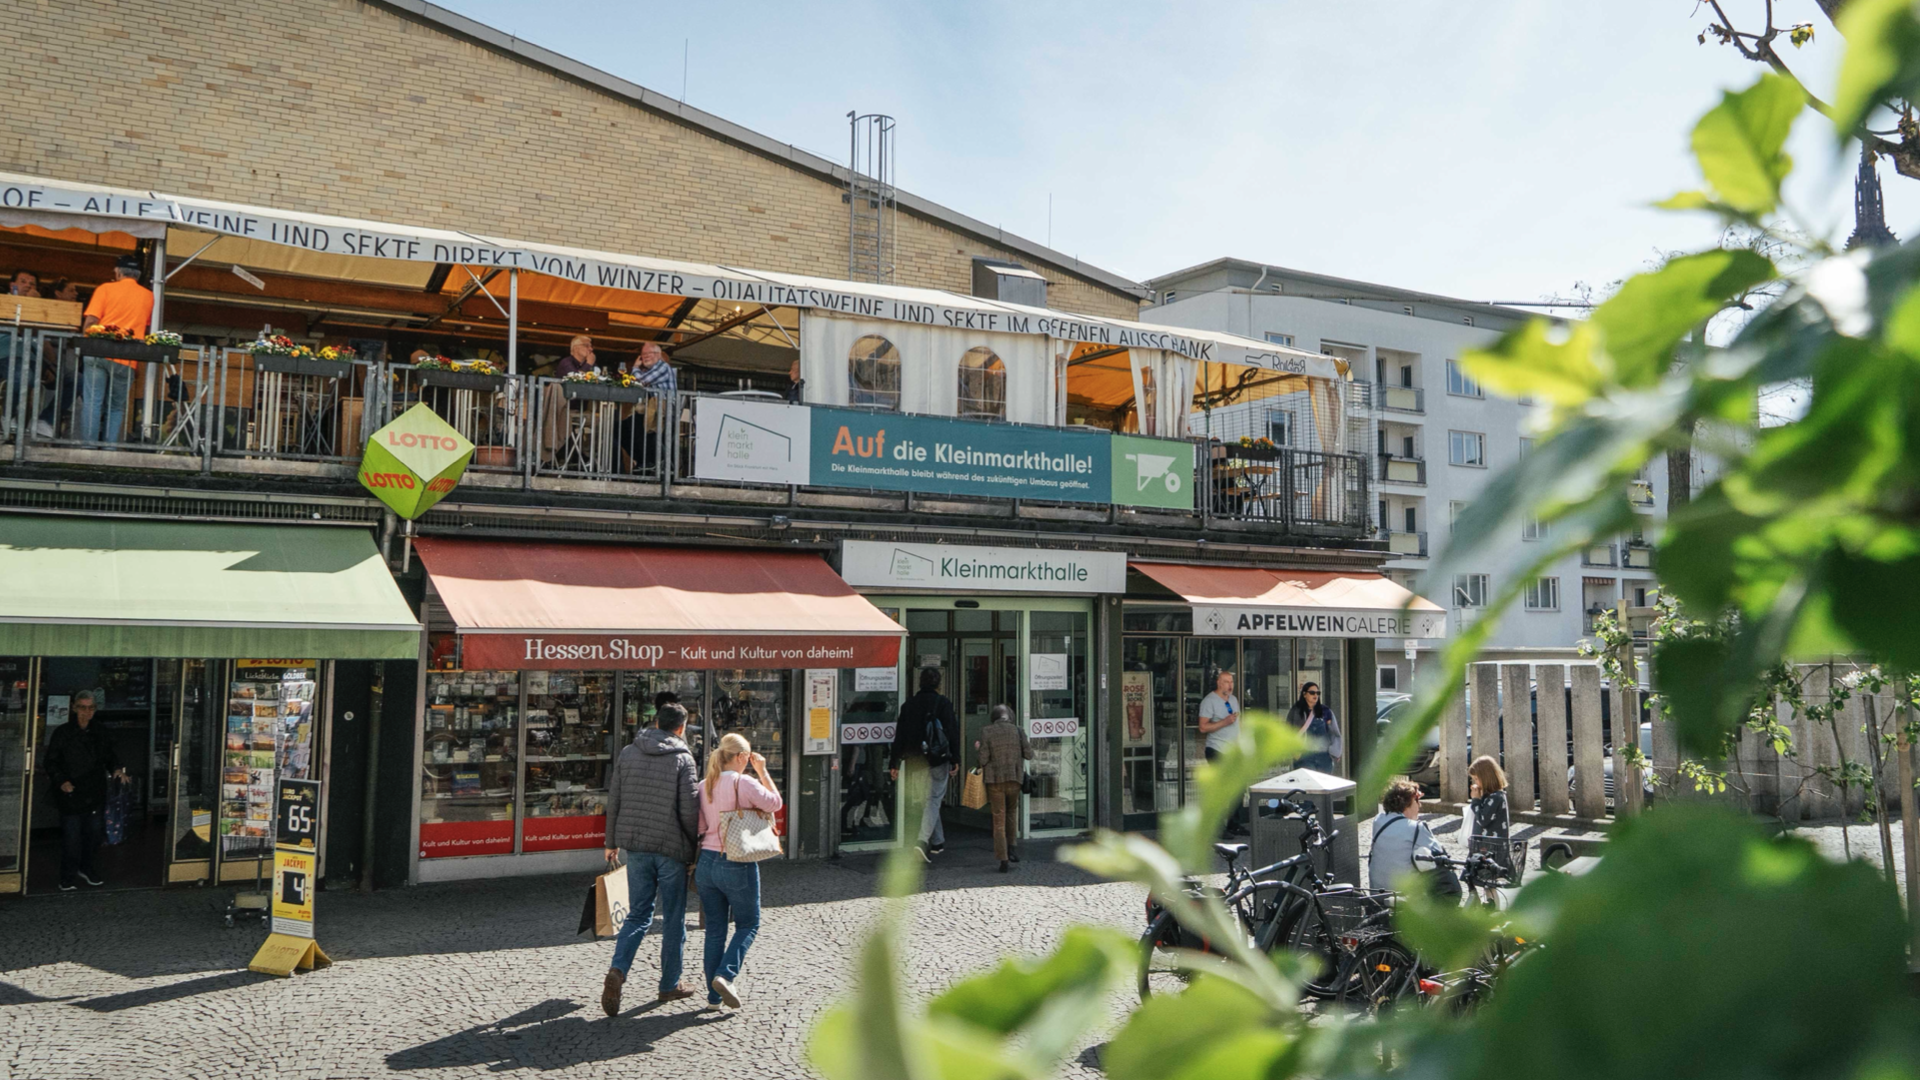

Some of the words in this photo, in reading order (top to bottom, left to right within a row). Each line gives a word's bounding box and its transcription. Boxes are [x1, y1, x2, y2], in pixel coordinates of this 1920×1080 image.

[272, 223, 329, 251] UND
[597, 265, 684, 294] WINZER
[894, 303, 935, 324] UND
[1007, 316, 1029, 333] IM
[388, 431, 458, 451] LOTTO
[728, 429, 749, 440] klein
[727, 450, 750, 459] halle
[728, 441, 753, 450] markt
[832, 425, 885, 458] Auf
[893, 440, 927, 462] die
[935, 443, 1093, 474] Kleinmarkthalle!
[364, 472, 415, 490] LOTTO
[427, 477, 456, 493] LOTTO
[832, 463, 845, 473] Die
[847, 464, 909, 477] Kleinmarkthalle
[911, 467, 934, 479] bleibt
[936, 469, 969, 481] während
[971, 473, 985, 482] des
[987, 473, 1028, 486] zukünftigen
[1029, 477, 1058, 488] Umbaus
[1059, 479, 1090, 490] geöffnet.
[941, 557, 1088, 581] Kleinmarkthalle
[1236, 613, 1411, 634] APFELWEINGALERIE
[524, 638, 606, 660] Hessen
[609, 638, 664, 666] Shop
[681, 645, 706, 659] Kult
[710, 647, 735, 659] und
[740, 645, 778, 659] Kultur
[781, 648, 803, 659] von
[807, 645, 853, 659] daheim!
[1123, 683, 1145, 692] ROSÉ
[288, 804, 312, 833] 65
[485, 836, 511, 844] daheim!
[283, 858, 307, 869] JACKPOT
[293, 877, 305, 902] 4
